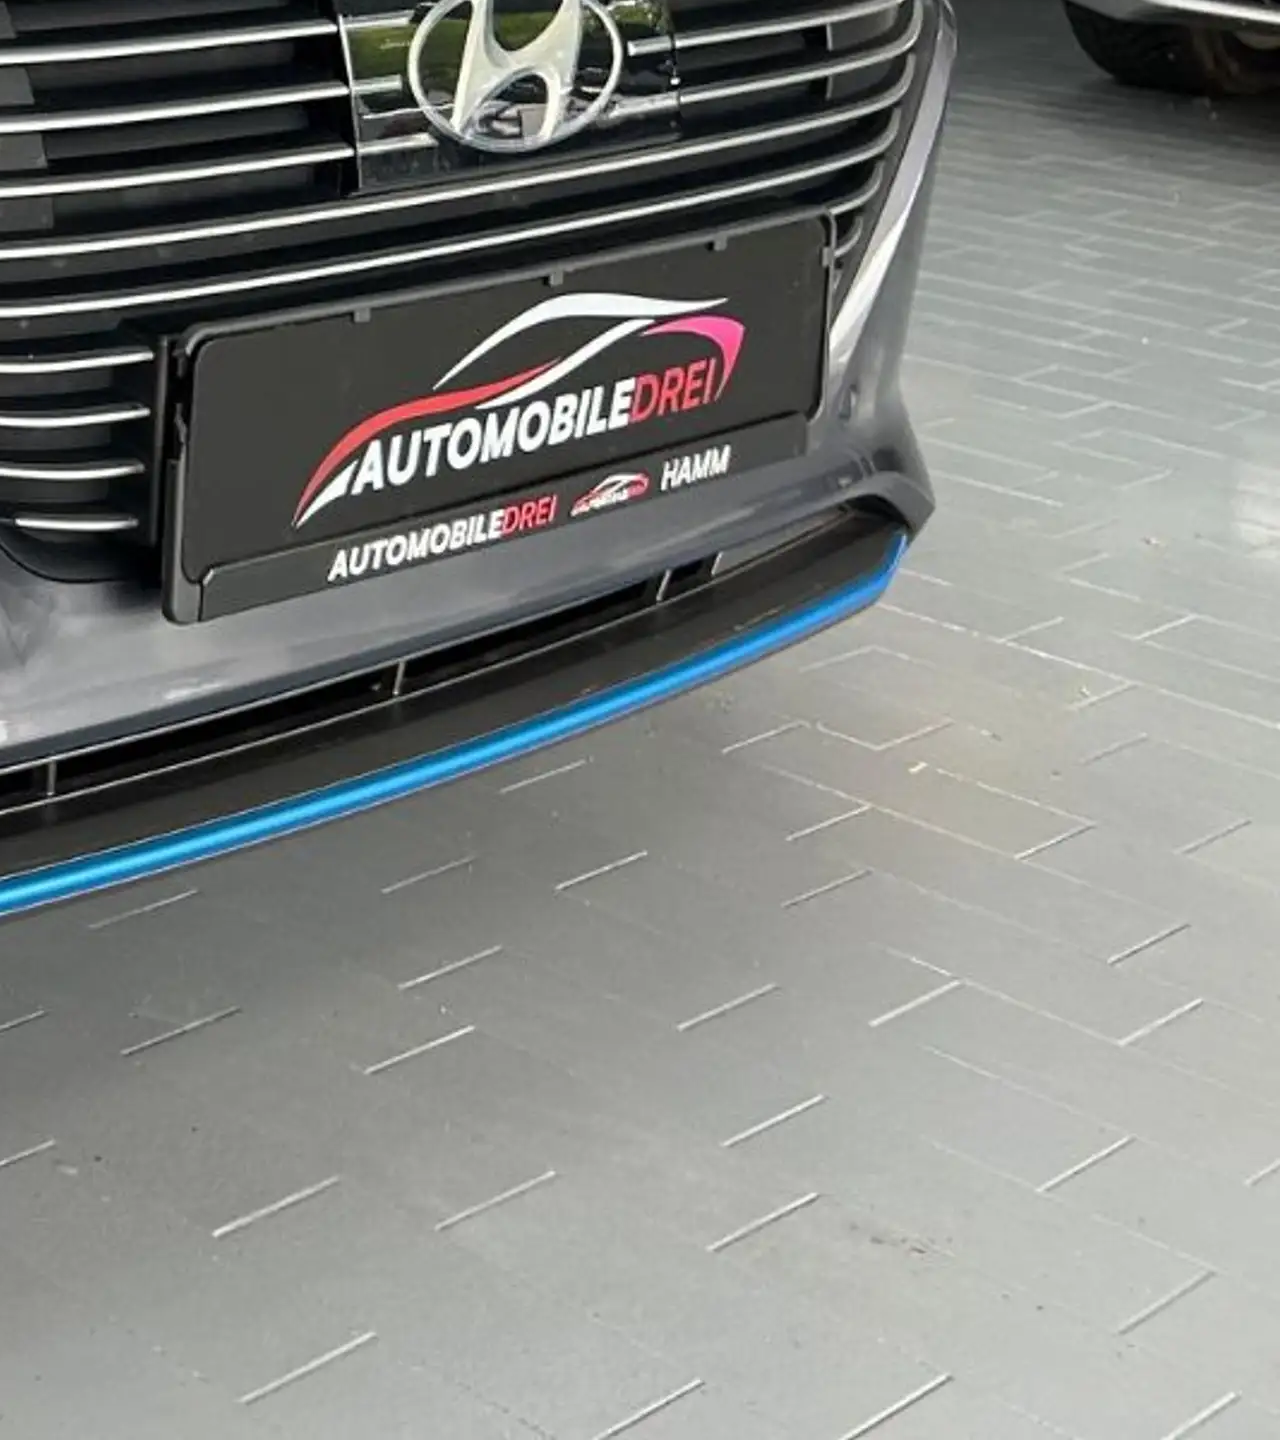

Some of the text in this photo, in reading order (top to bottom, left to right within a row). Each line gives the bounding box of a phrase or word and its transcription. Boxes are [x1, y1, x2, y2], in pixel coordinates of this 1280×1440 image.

[351, 357, 717, 496] AUTOMOBILEDREI
[326, 494, 559, 583] AUTOMOBILEDREI
[660, 444, 732, 492] HAMM
